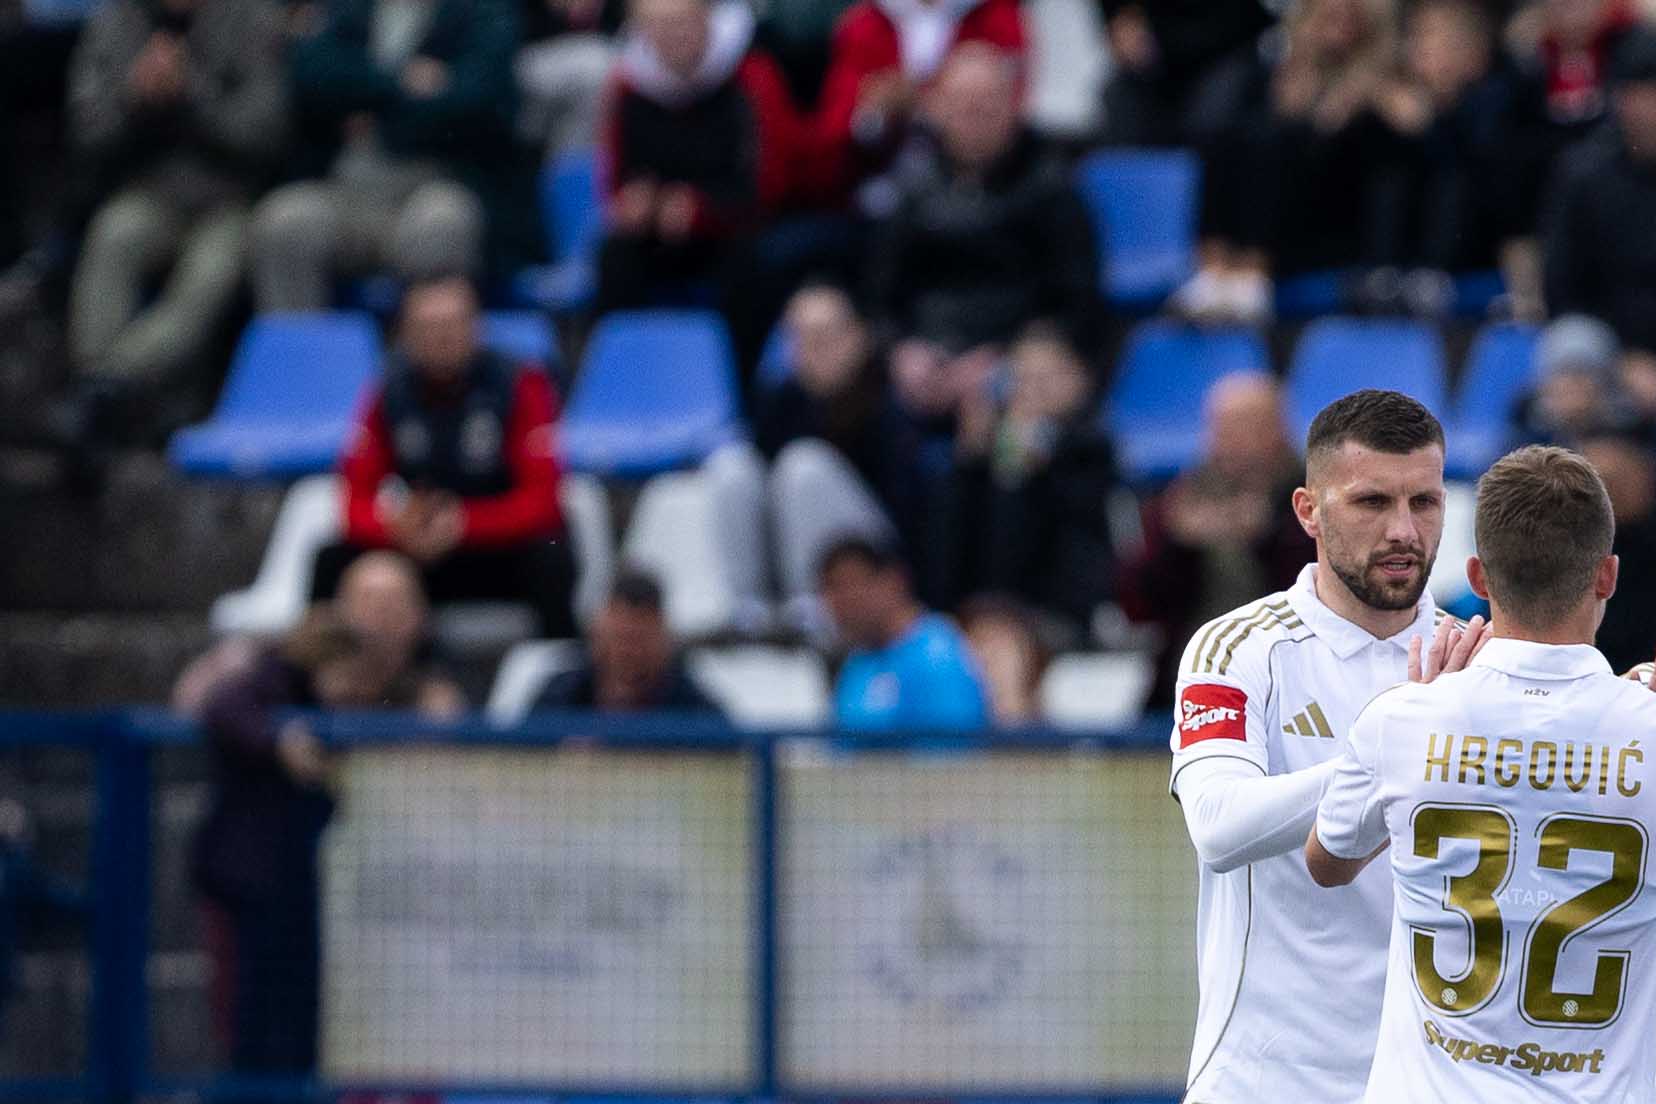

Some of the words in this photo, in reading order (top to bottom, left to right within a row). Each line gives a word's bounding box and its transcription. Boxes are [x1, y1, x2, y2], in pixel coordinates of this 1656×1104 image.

[1424, 734, 1644, 797] HRGOVIĆ
[1409, 801, 1650, 1030] 32
[1424, 1019, 1605, 1076] SuperSport
